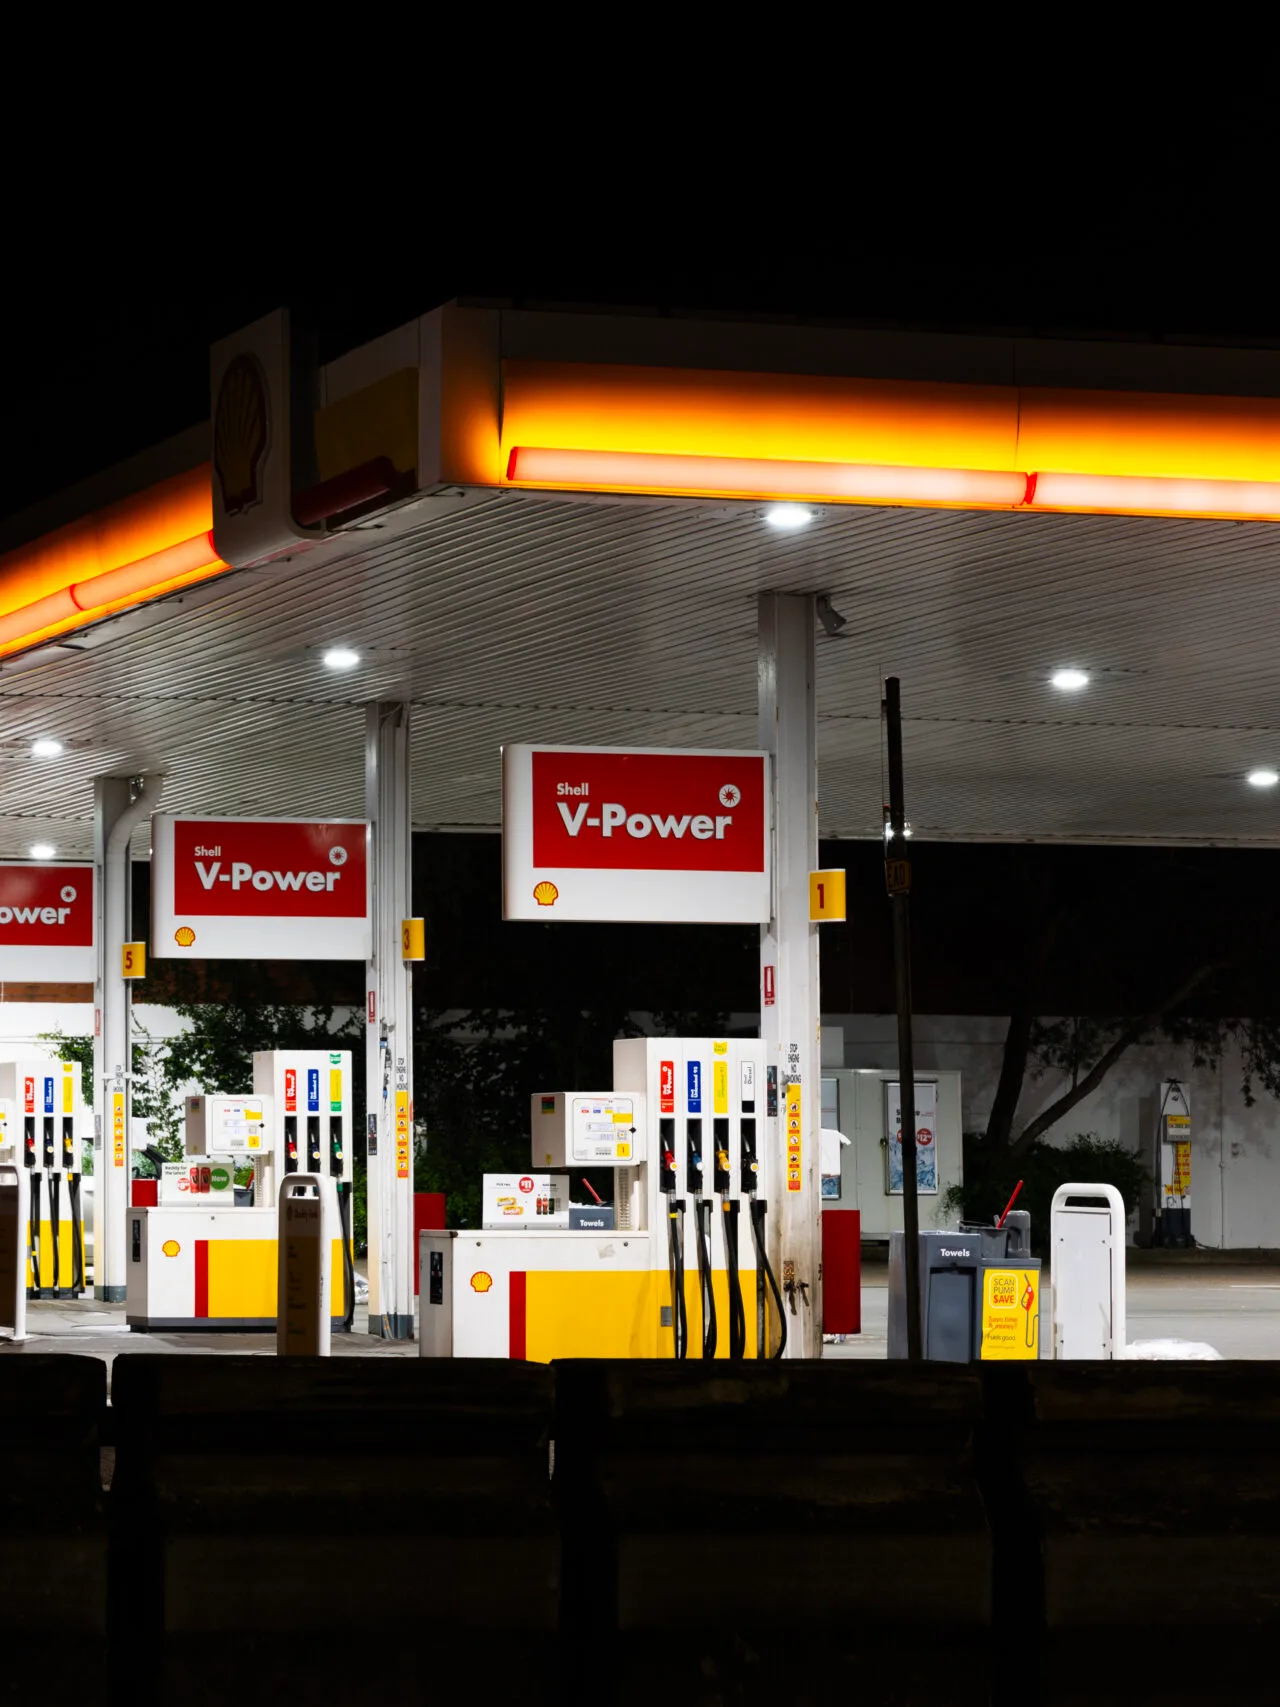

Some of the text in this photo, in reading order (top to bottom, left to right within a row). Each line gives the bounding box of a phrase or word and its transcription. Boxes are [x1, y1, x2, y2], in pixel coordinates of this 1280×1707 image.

[557, 782, 589, 796] Shell
[556, 803, 732, 840] V-Power
[194, 845, 221, 857] Shell
[194, 861, 341, 892] V-Power
[816, 883, 825, 909] 1
[125, 951, 133, 970] 5
[789, 1043, 798, 1053] STOP
[579, 1219, 605, 1227] Towels
[939, 1248, 970, 1257] Towels
[993, 1278, 1015, 1286] SCAN
[993, 1286, 1015, 1294] PUMP
[993, 1295, 1015, 1304] SAVE
